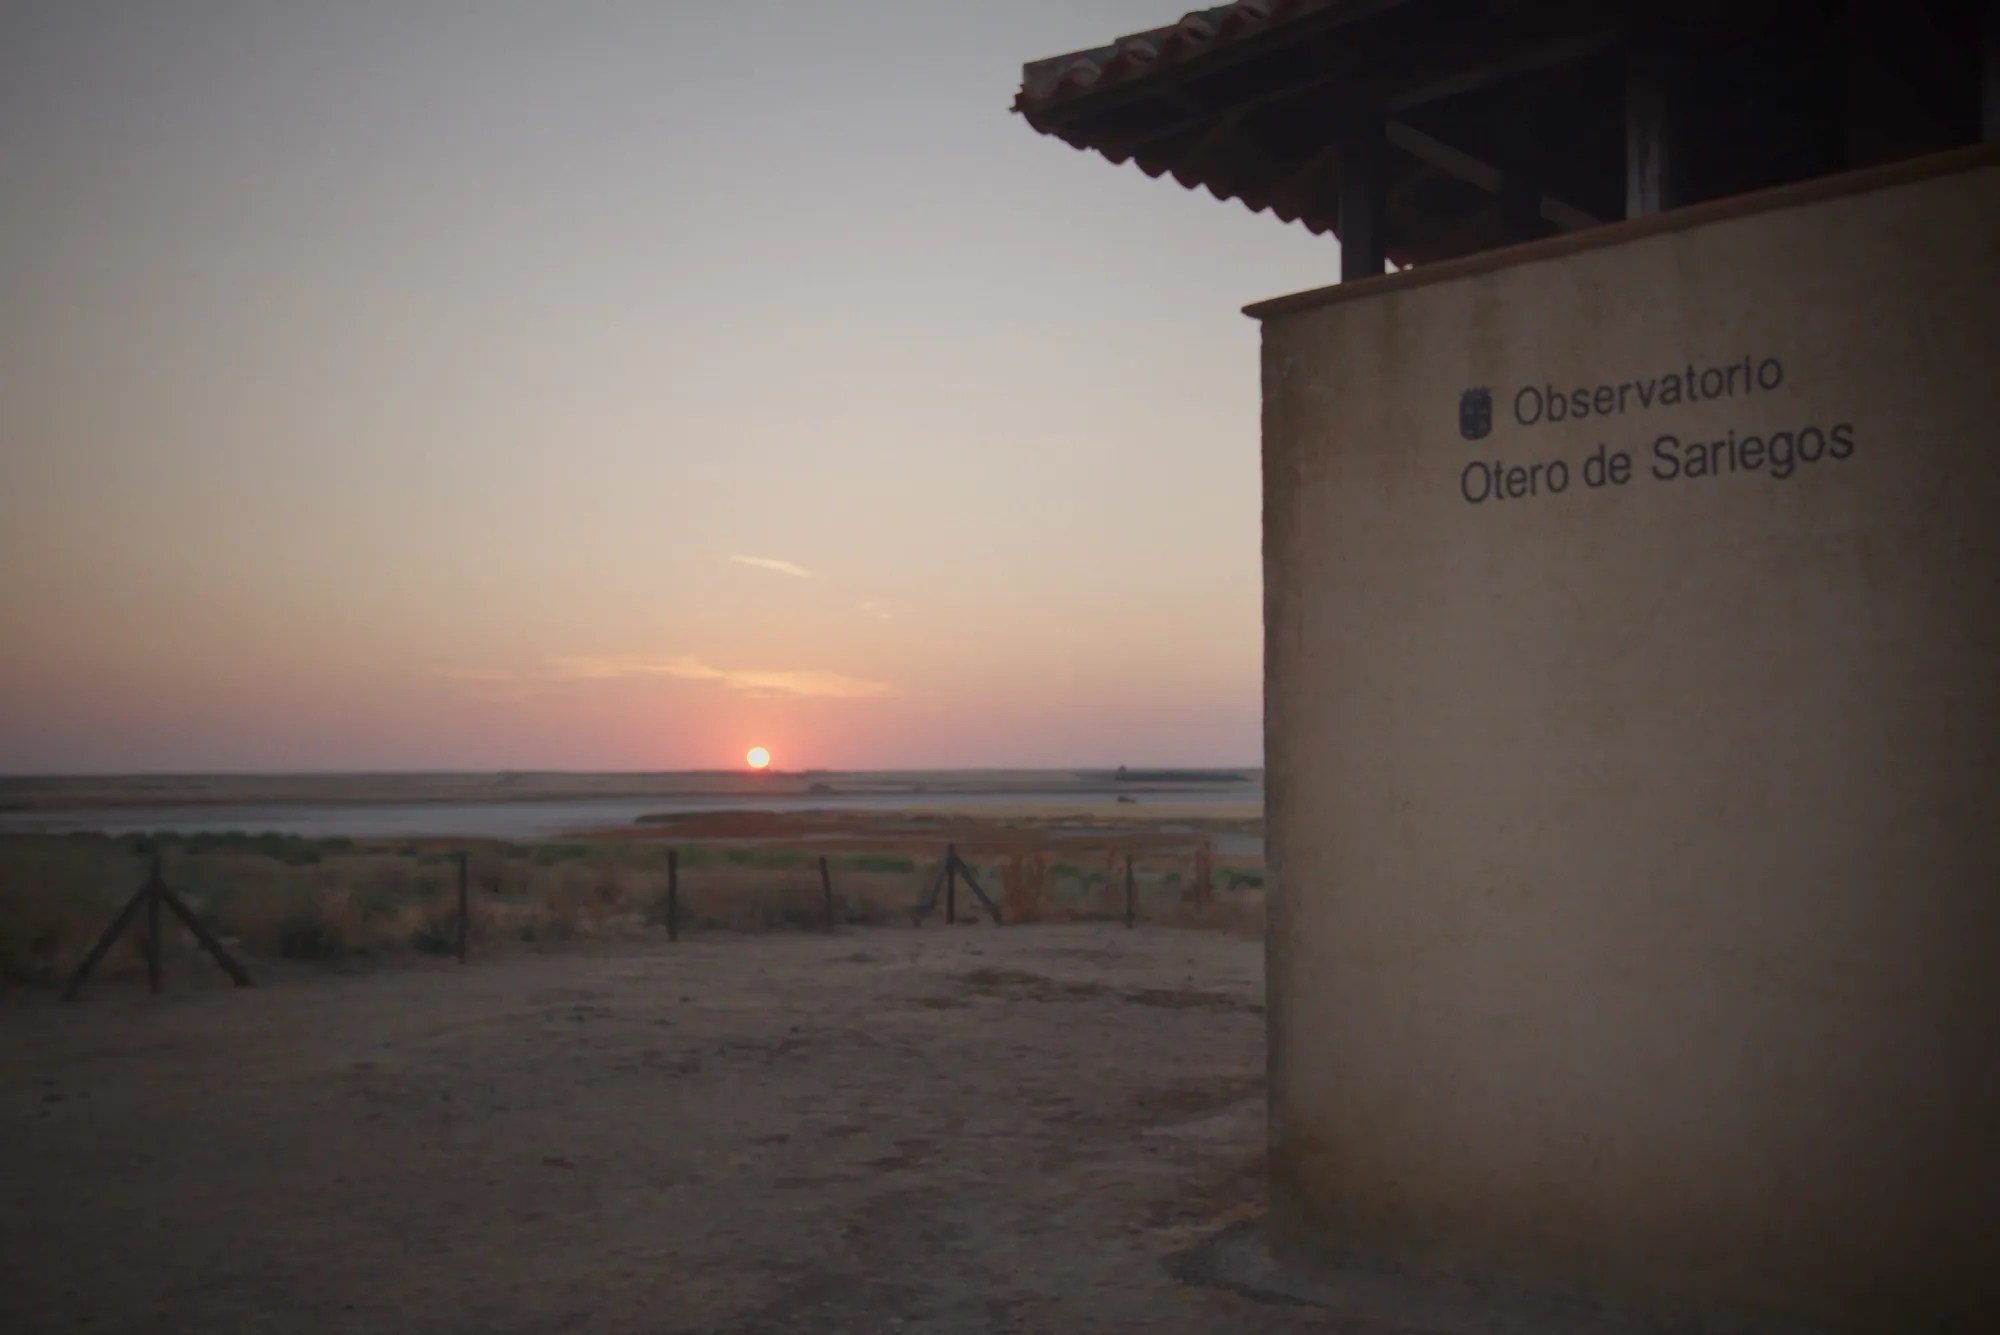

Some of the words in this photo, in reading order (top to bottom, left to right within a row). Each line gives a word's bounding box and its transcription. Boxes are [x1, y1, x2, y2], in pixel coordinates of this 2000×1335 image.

[1514, 355, 1783, 425] Observatorio
[1461, 460, 1570, 504] Otero
[1584, 444, 1632, 487] de
[1652, 423, 1854, 480] Sariegos
